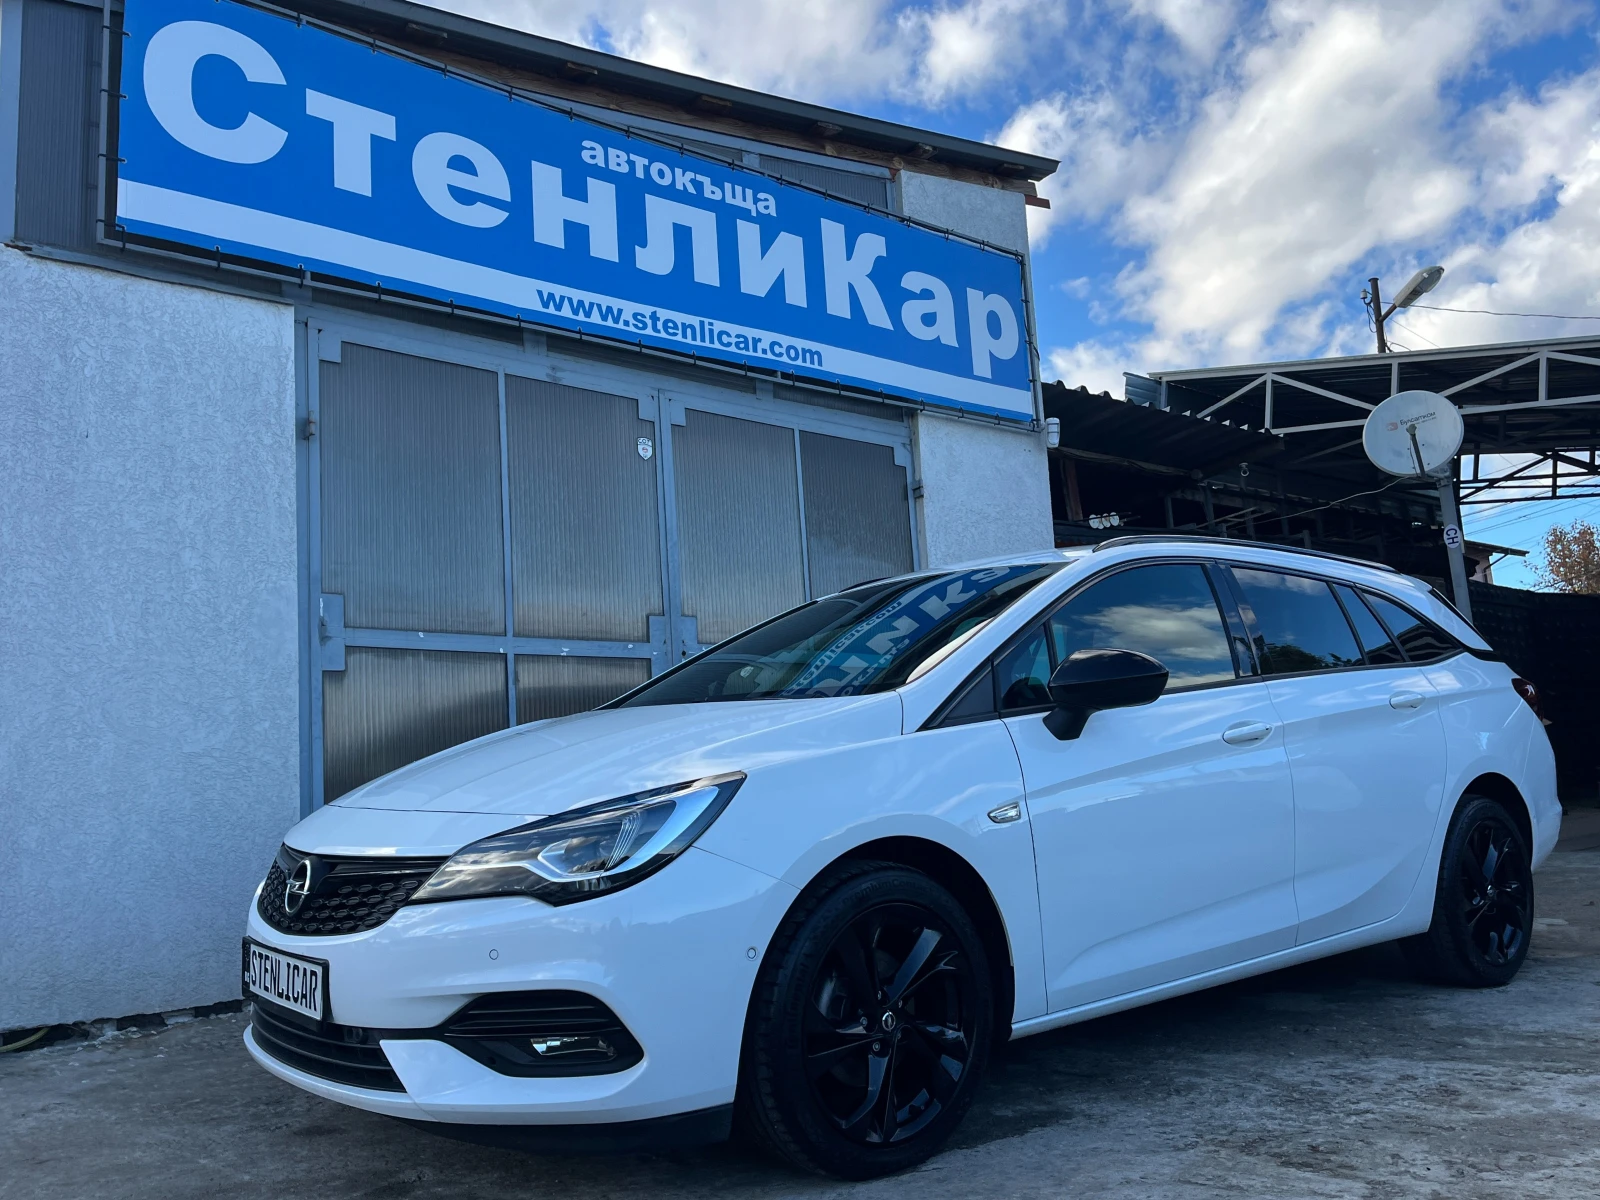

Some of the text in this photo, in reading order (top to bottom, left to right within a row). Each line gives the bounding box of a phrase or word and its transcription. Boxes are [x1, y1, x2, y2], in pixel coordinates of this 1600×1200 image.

[143, 20, 1019, 379] СтенлиКар
[581, 140, 777, 217] автокъща
[536, 288, 823, 368] www.stenlicar.com
[250, 949, 318, 1012] STENLICAR
